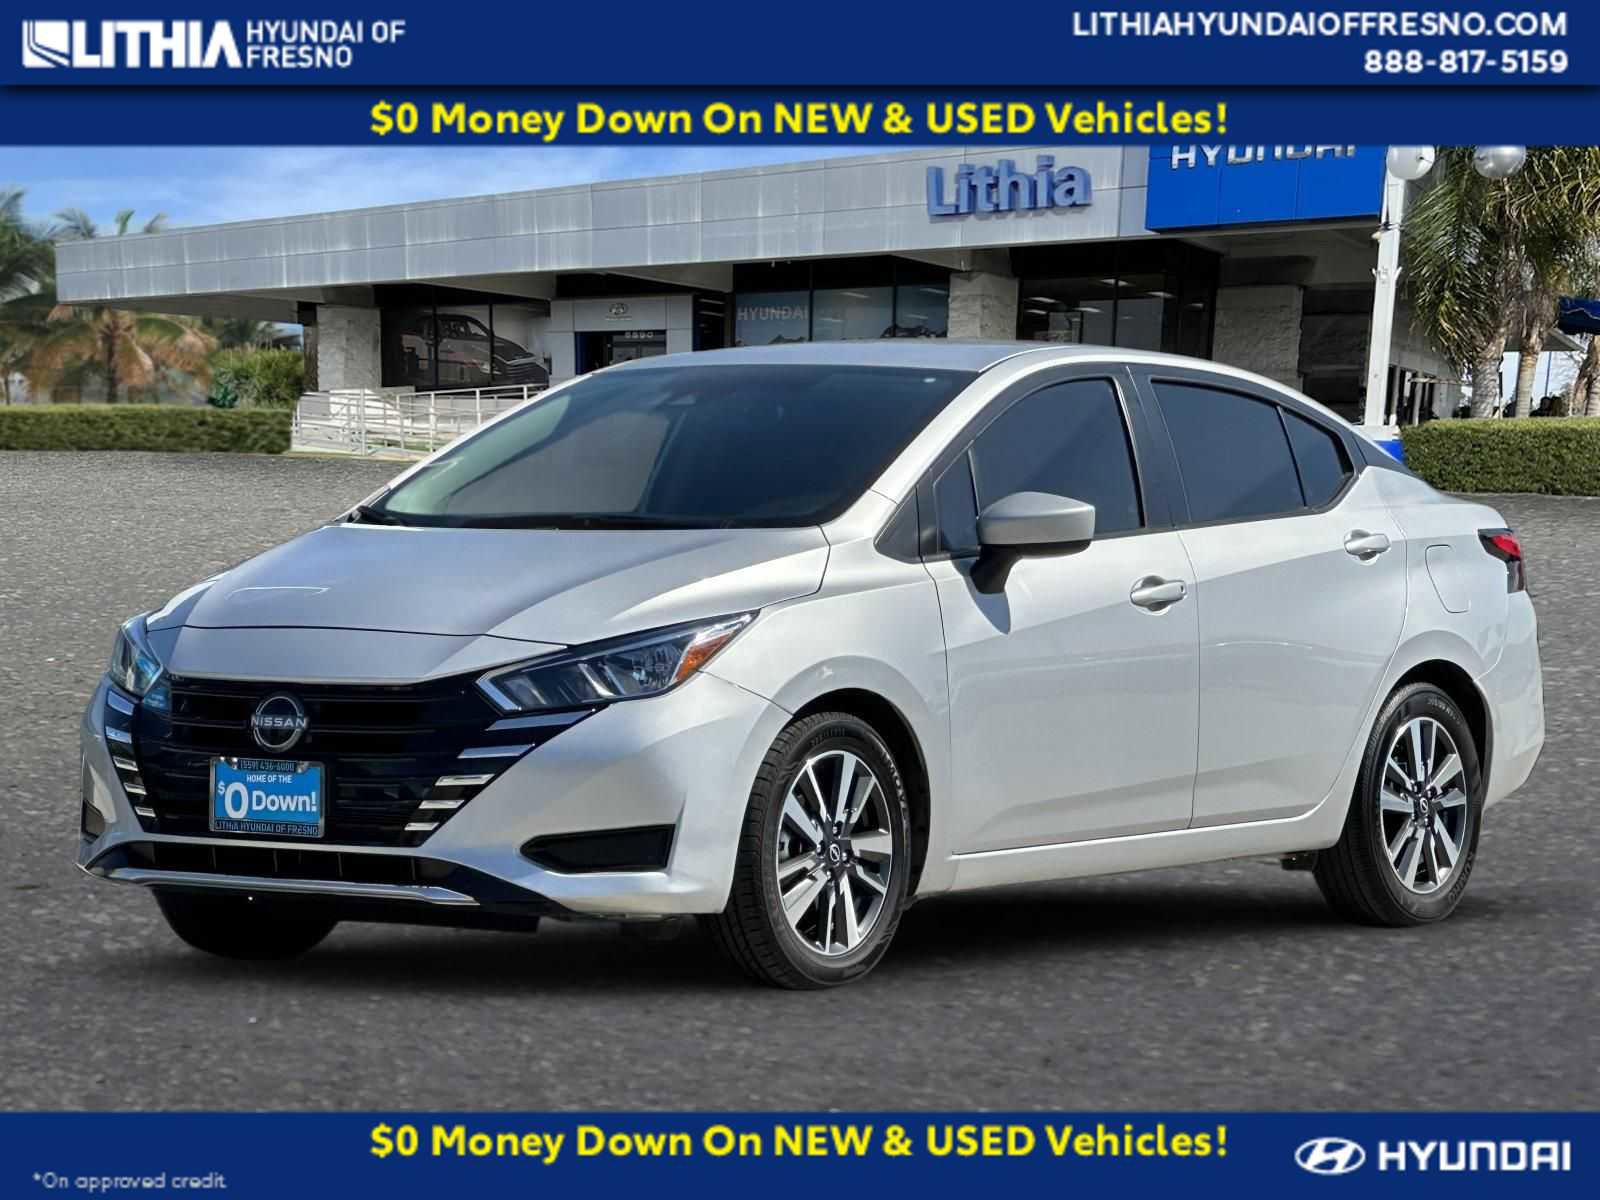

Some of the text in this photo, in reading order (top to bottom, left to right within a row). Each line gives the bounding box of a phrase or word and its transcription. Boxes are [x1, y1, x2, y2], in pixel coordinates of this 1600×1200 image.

[926, 155, 1092, 217] Lithia
[737, 305, 809, 321] HYUNDAI
[250, 715, 308, 728] NISSAN
[246, 773, 293, 784] HOME OF THE
[252, 790, 317, 812] Down!
[240, 822, 274, 832] HYUNDAI
[275, 823, 286, 832] OF
[287, 824, 319, 835] FRESNO
